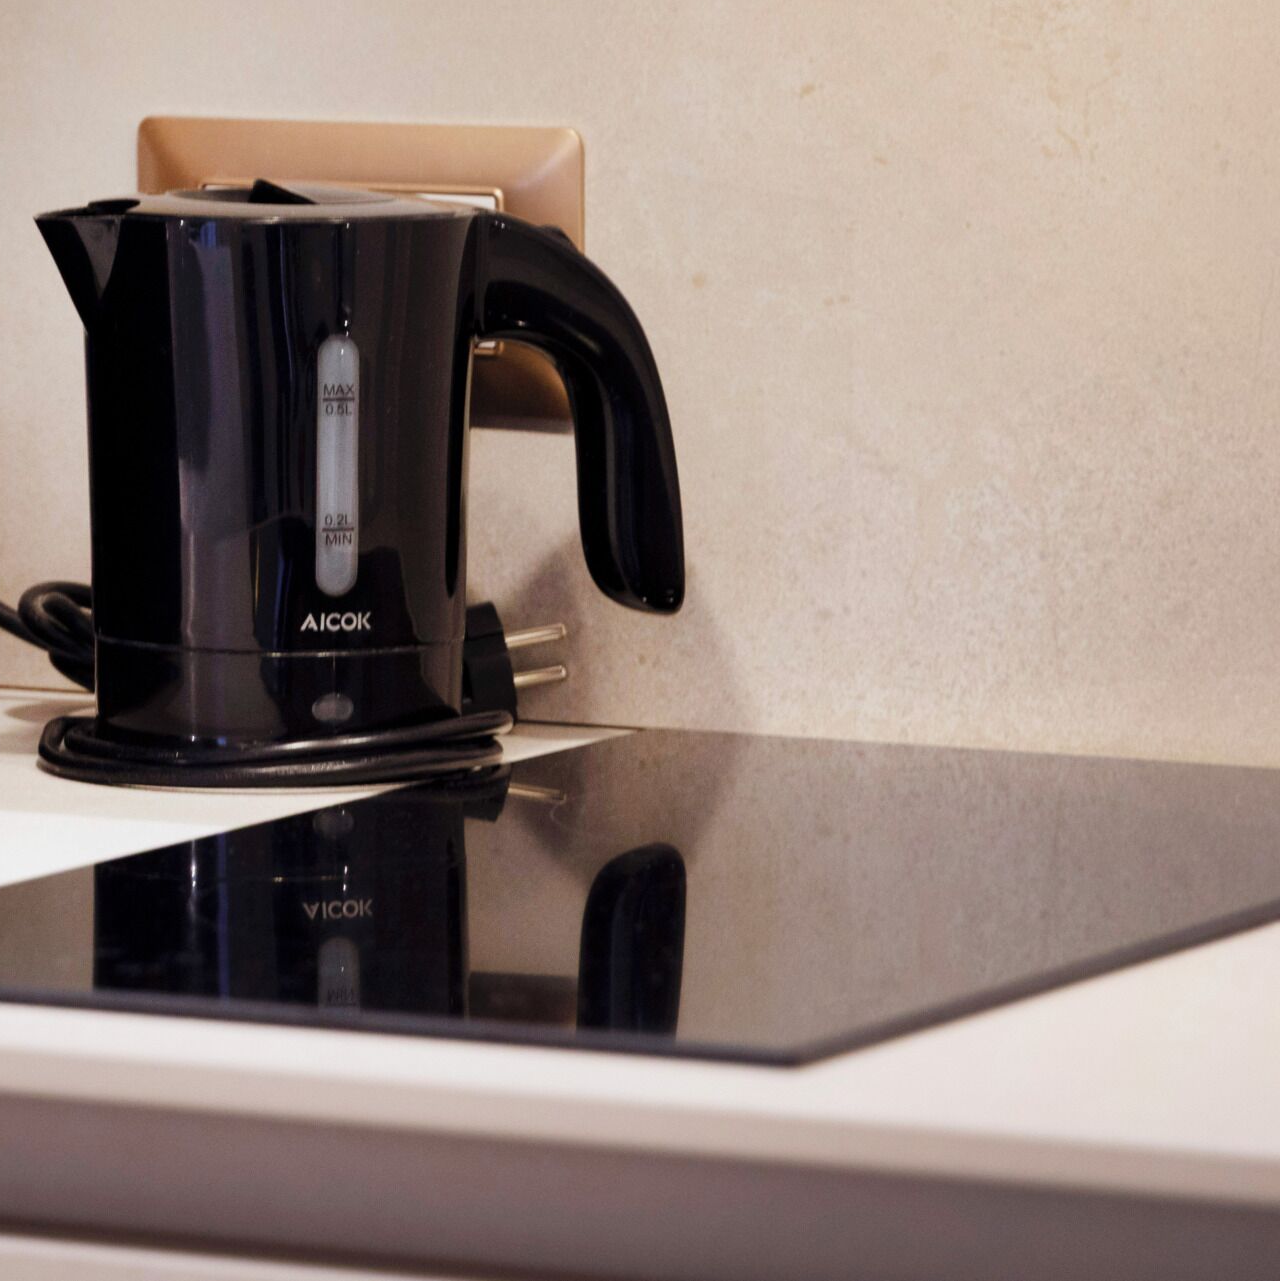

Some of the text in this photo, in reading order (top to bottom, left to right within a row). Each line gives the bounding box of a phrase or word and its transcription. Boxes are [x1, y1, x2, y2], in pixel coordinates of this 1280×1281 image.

[323, 384, 355, 397] MAX
[325, 403, 352, 417] 0.5L
[324, 514, 352, 527] 0.2L
[325, 533, 353, 546] MIN
[300, 611, 372, 633] AICOK
